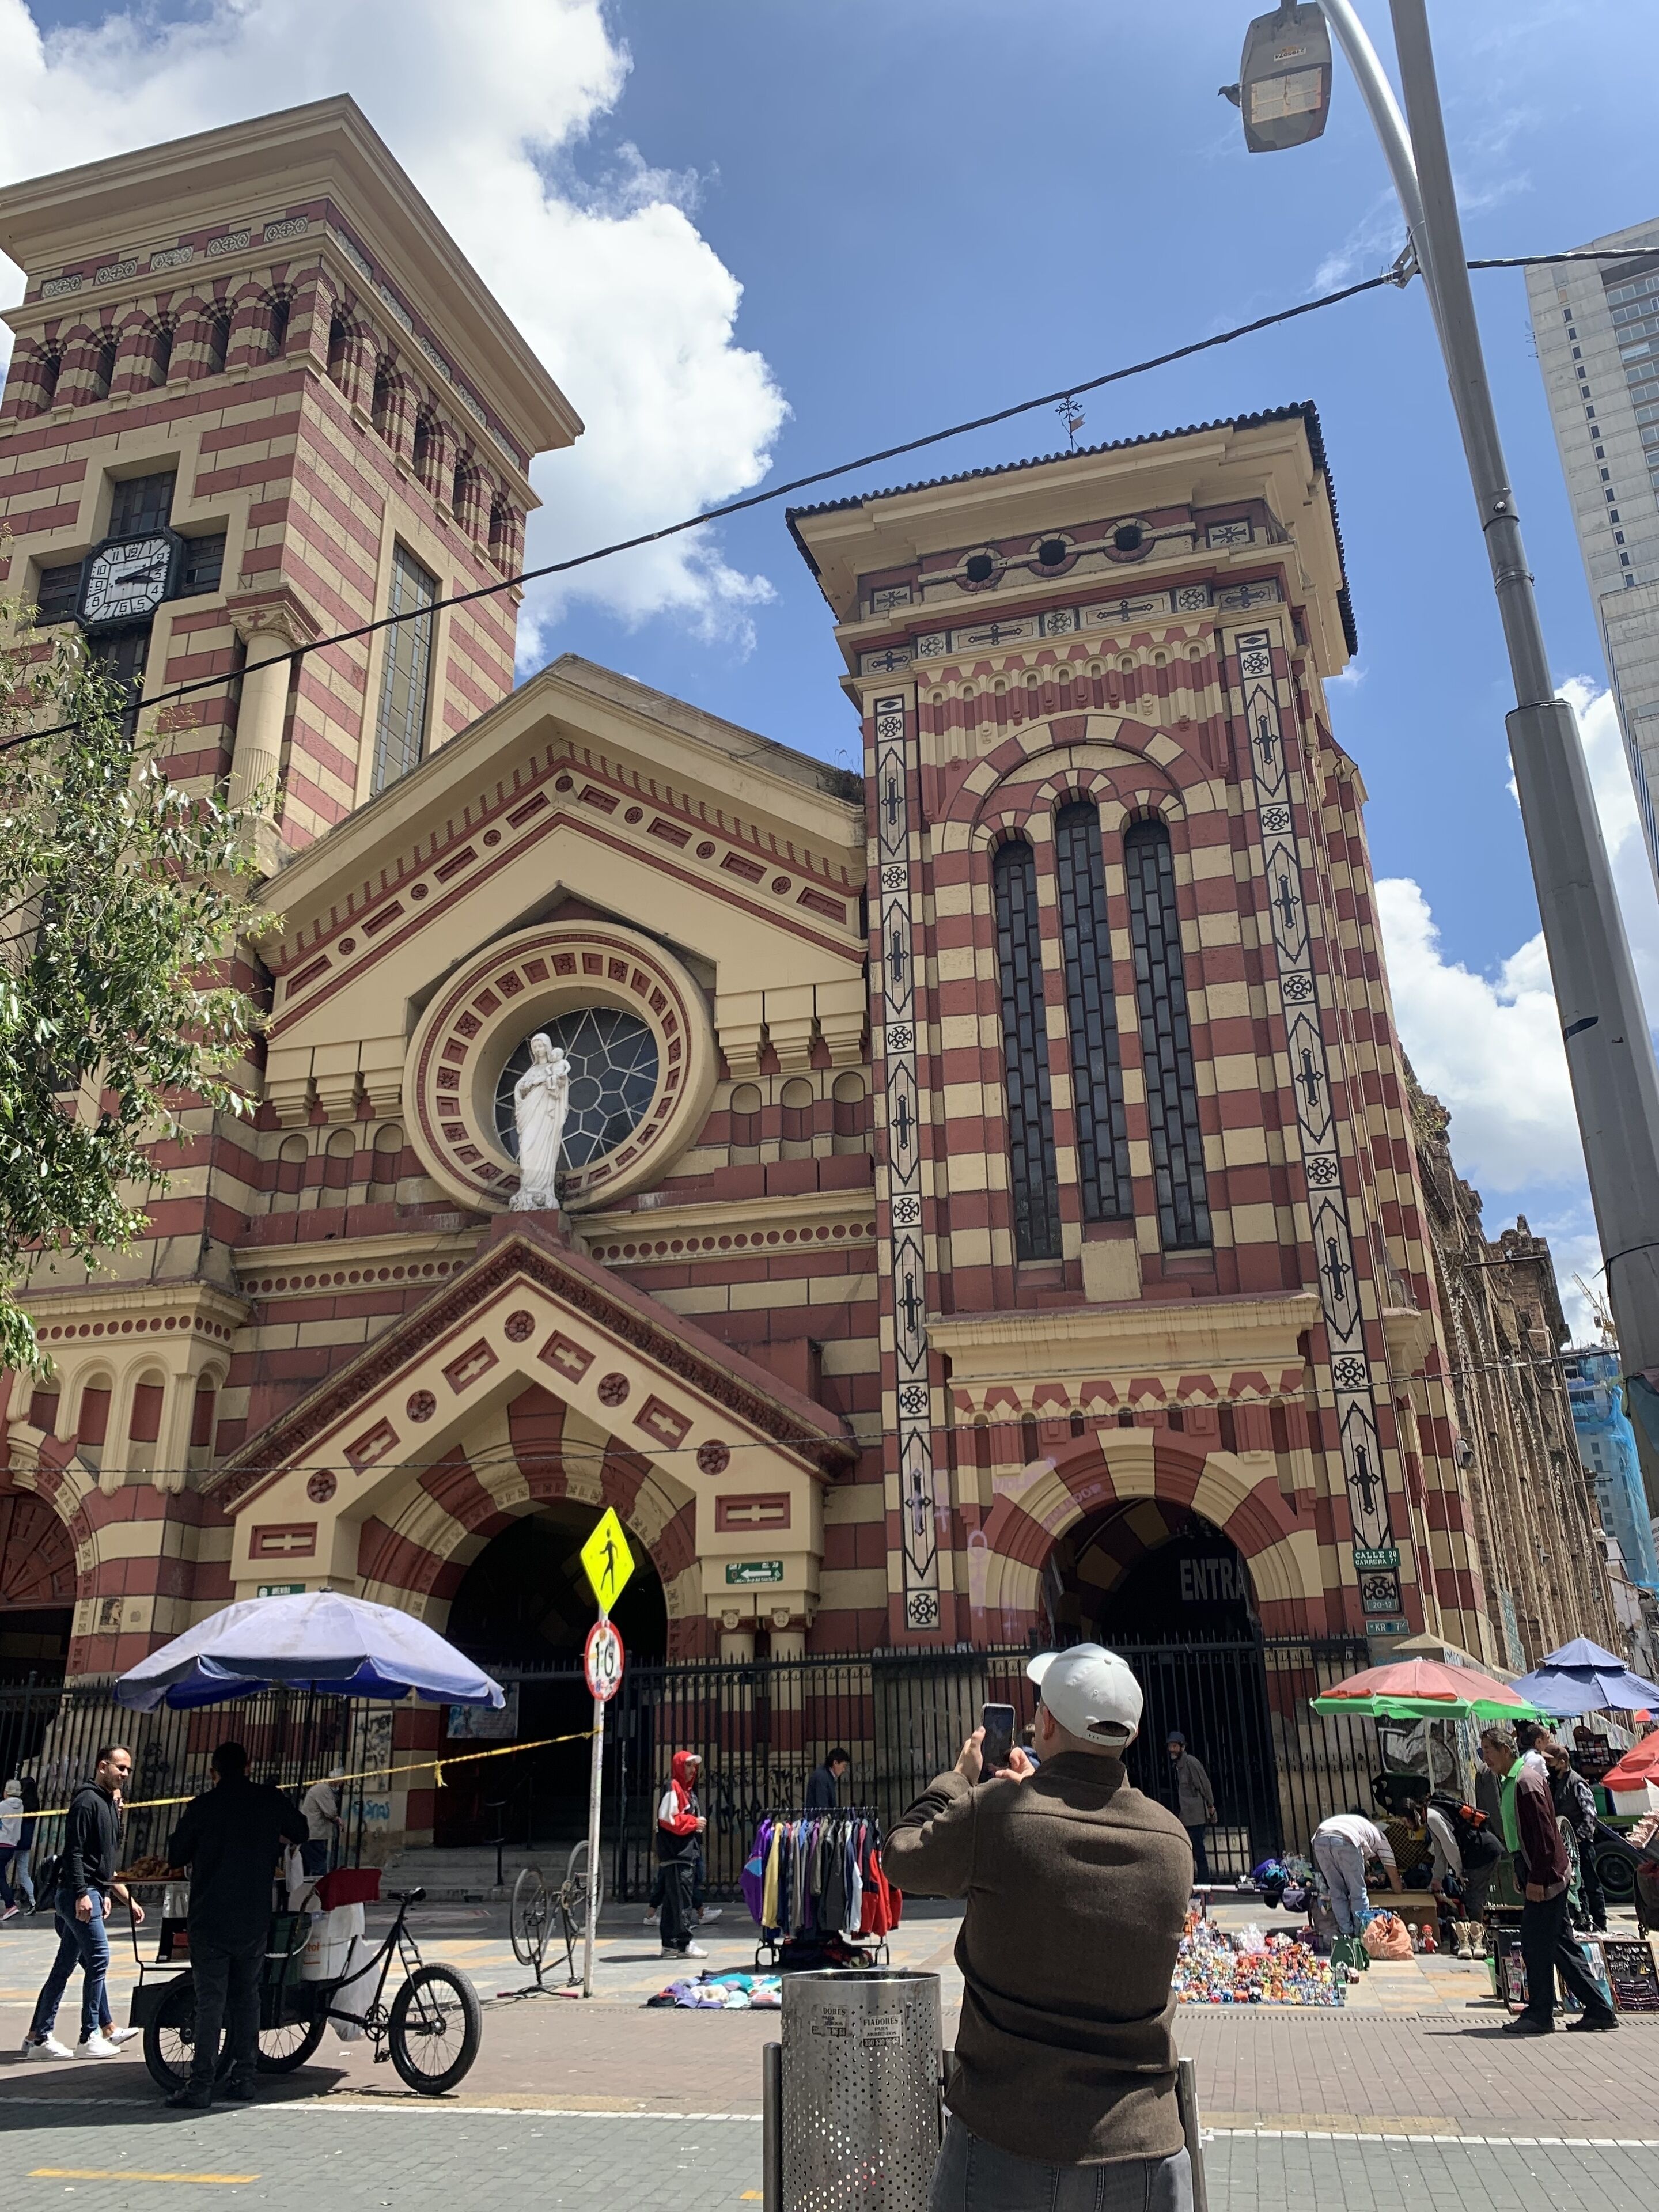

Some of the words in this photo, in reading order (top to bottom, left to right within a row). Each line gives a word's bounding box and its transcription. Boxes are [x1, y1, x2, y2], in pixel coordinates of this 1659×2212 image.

[112, 551, 119, 562] 11
[128, 547, 138, 559] 12
[97, 565, 107, 575] 10
[155, 569, 162, 579] 3
[95, 581, 103, 592] 9
[151, 585, 159, 595] 4
[92, 597, 100, 607] 8
[137, 599, 145, 609] 5
[104, 605, 111, 616] 7
[119, 603, 128, 613] 6
[1355, 1551, 1385, 1559] CALLE
[1389, 1550, 1397, 1558] 20
[1375, 1622, 1387, 1632] KR
[863, 2017, 899, 2026] FIADORES
